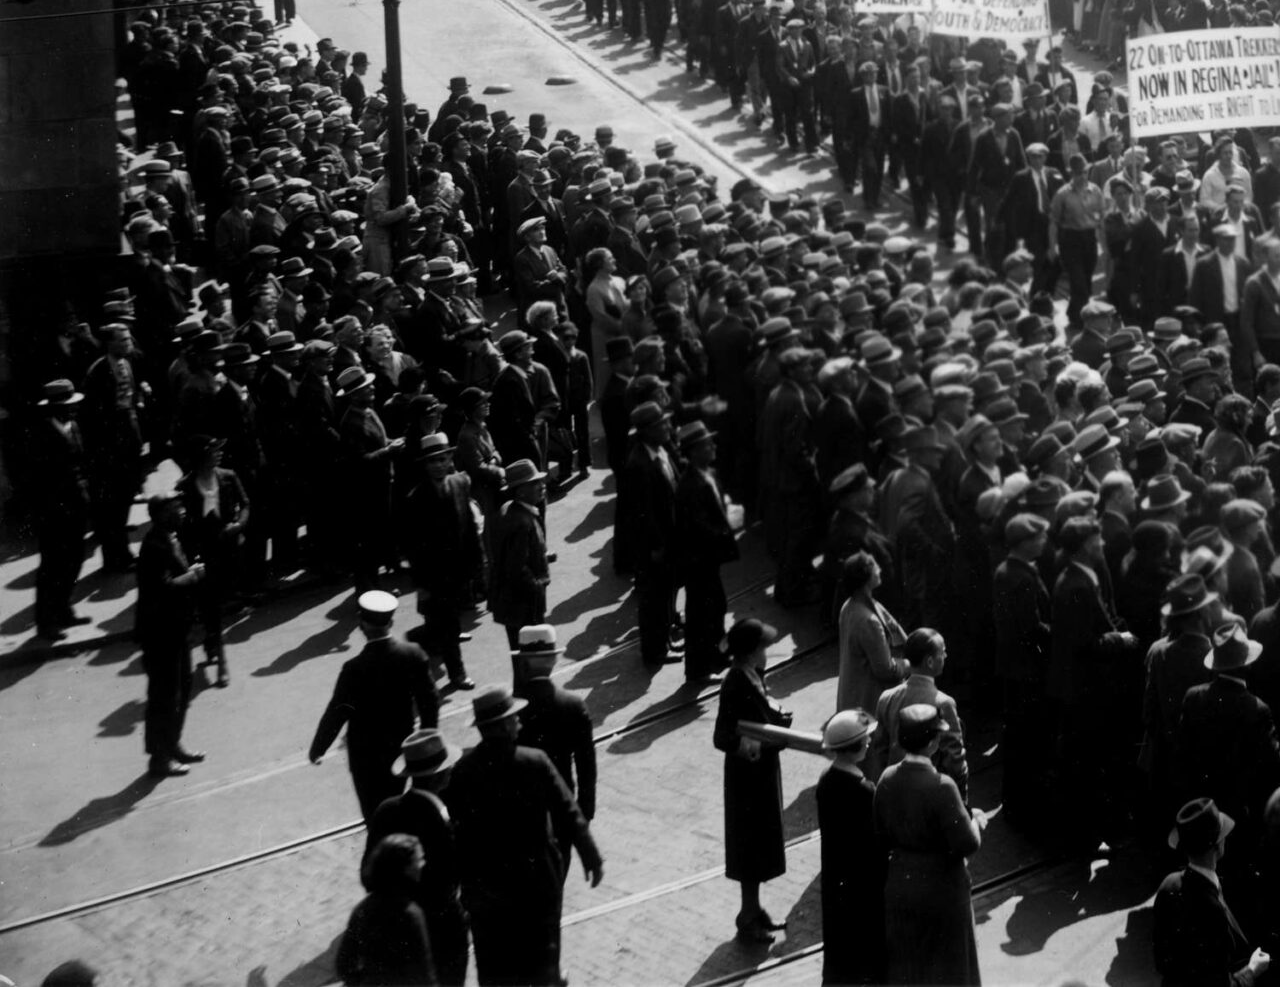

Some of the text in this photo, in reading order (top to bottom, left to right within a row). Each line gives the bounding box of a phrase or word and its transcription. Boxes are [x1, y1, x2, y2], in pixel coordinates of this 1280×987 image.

[934, 10, 970, 29] OUTH
[1129, 46, 1145, 72] 22
[1139, 70, 1170, 102] NOW
[1173, 69, 1188, 97] IN
[1192, 64, 1242, 95] REGINA
[1151, 104, 1205, 126] DEMANDING
[1208, 101, 1225, 120] THE
